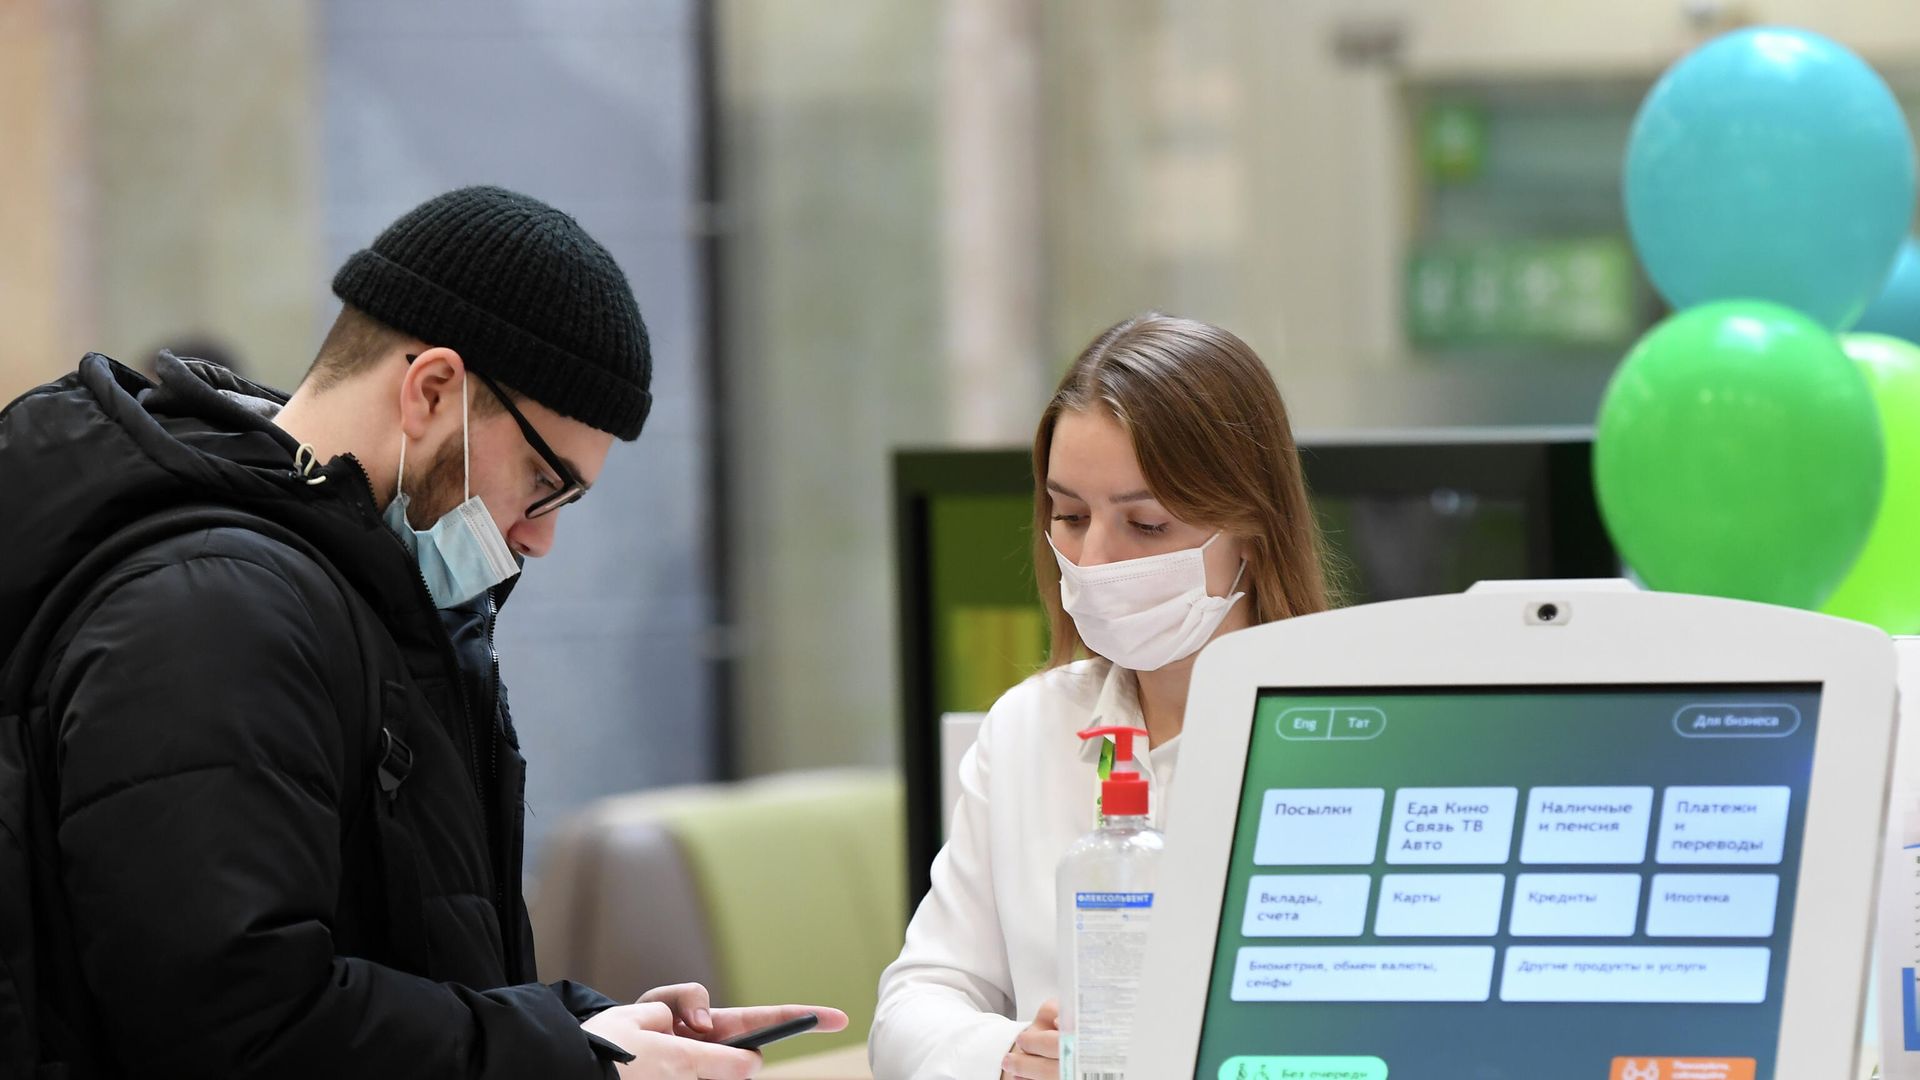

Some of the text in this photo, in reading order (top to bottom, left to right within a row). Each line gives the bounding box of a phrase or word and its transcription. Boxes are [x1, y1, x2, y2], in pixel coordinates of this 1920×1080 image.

[1293, 717, 1317, 732] Eng
[1348, 717, 1370, 729] Тат
[1693, 714, 1779, 729] Для бизнеса
[1275, 803, 1352, 816] Посылки
[1407, 802, 1489, 816] Еда Кино
[1541, 802, 1632, 815] Наличные
[1676, 801, 1757, 814] Платежи
[1404, 820, 1483, 833] Связь ТВ
[1539, 822, 1619, 832] и пенсия
[1674, 822, 1685, 832] и
[1401, 839, 1442, 851] Авто
[1671, 839, 1763, 852] переводы
[1260, 892, 1322, 906] Вклады,
[1393, 892, 1440, 905] Карты
[1529, 892, 1597, 905] Кредиты
[1665, 892, 1730, 903] Ипотека
[1257, 911, 1299, 921] счета
[1249, 961, 1437, 972] Биометрия, обмен валюты,
[1518, 961, 1706, 973] Другие продукты и услуги
[1246, 977, 1292, 989] сейфы
[1281, 1069, 1304, 1079] Без
